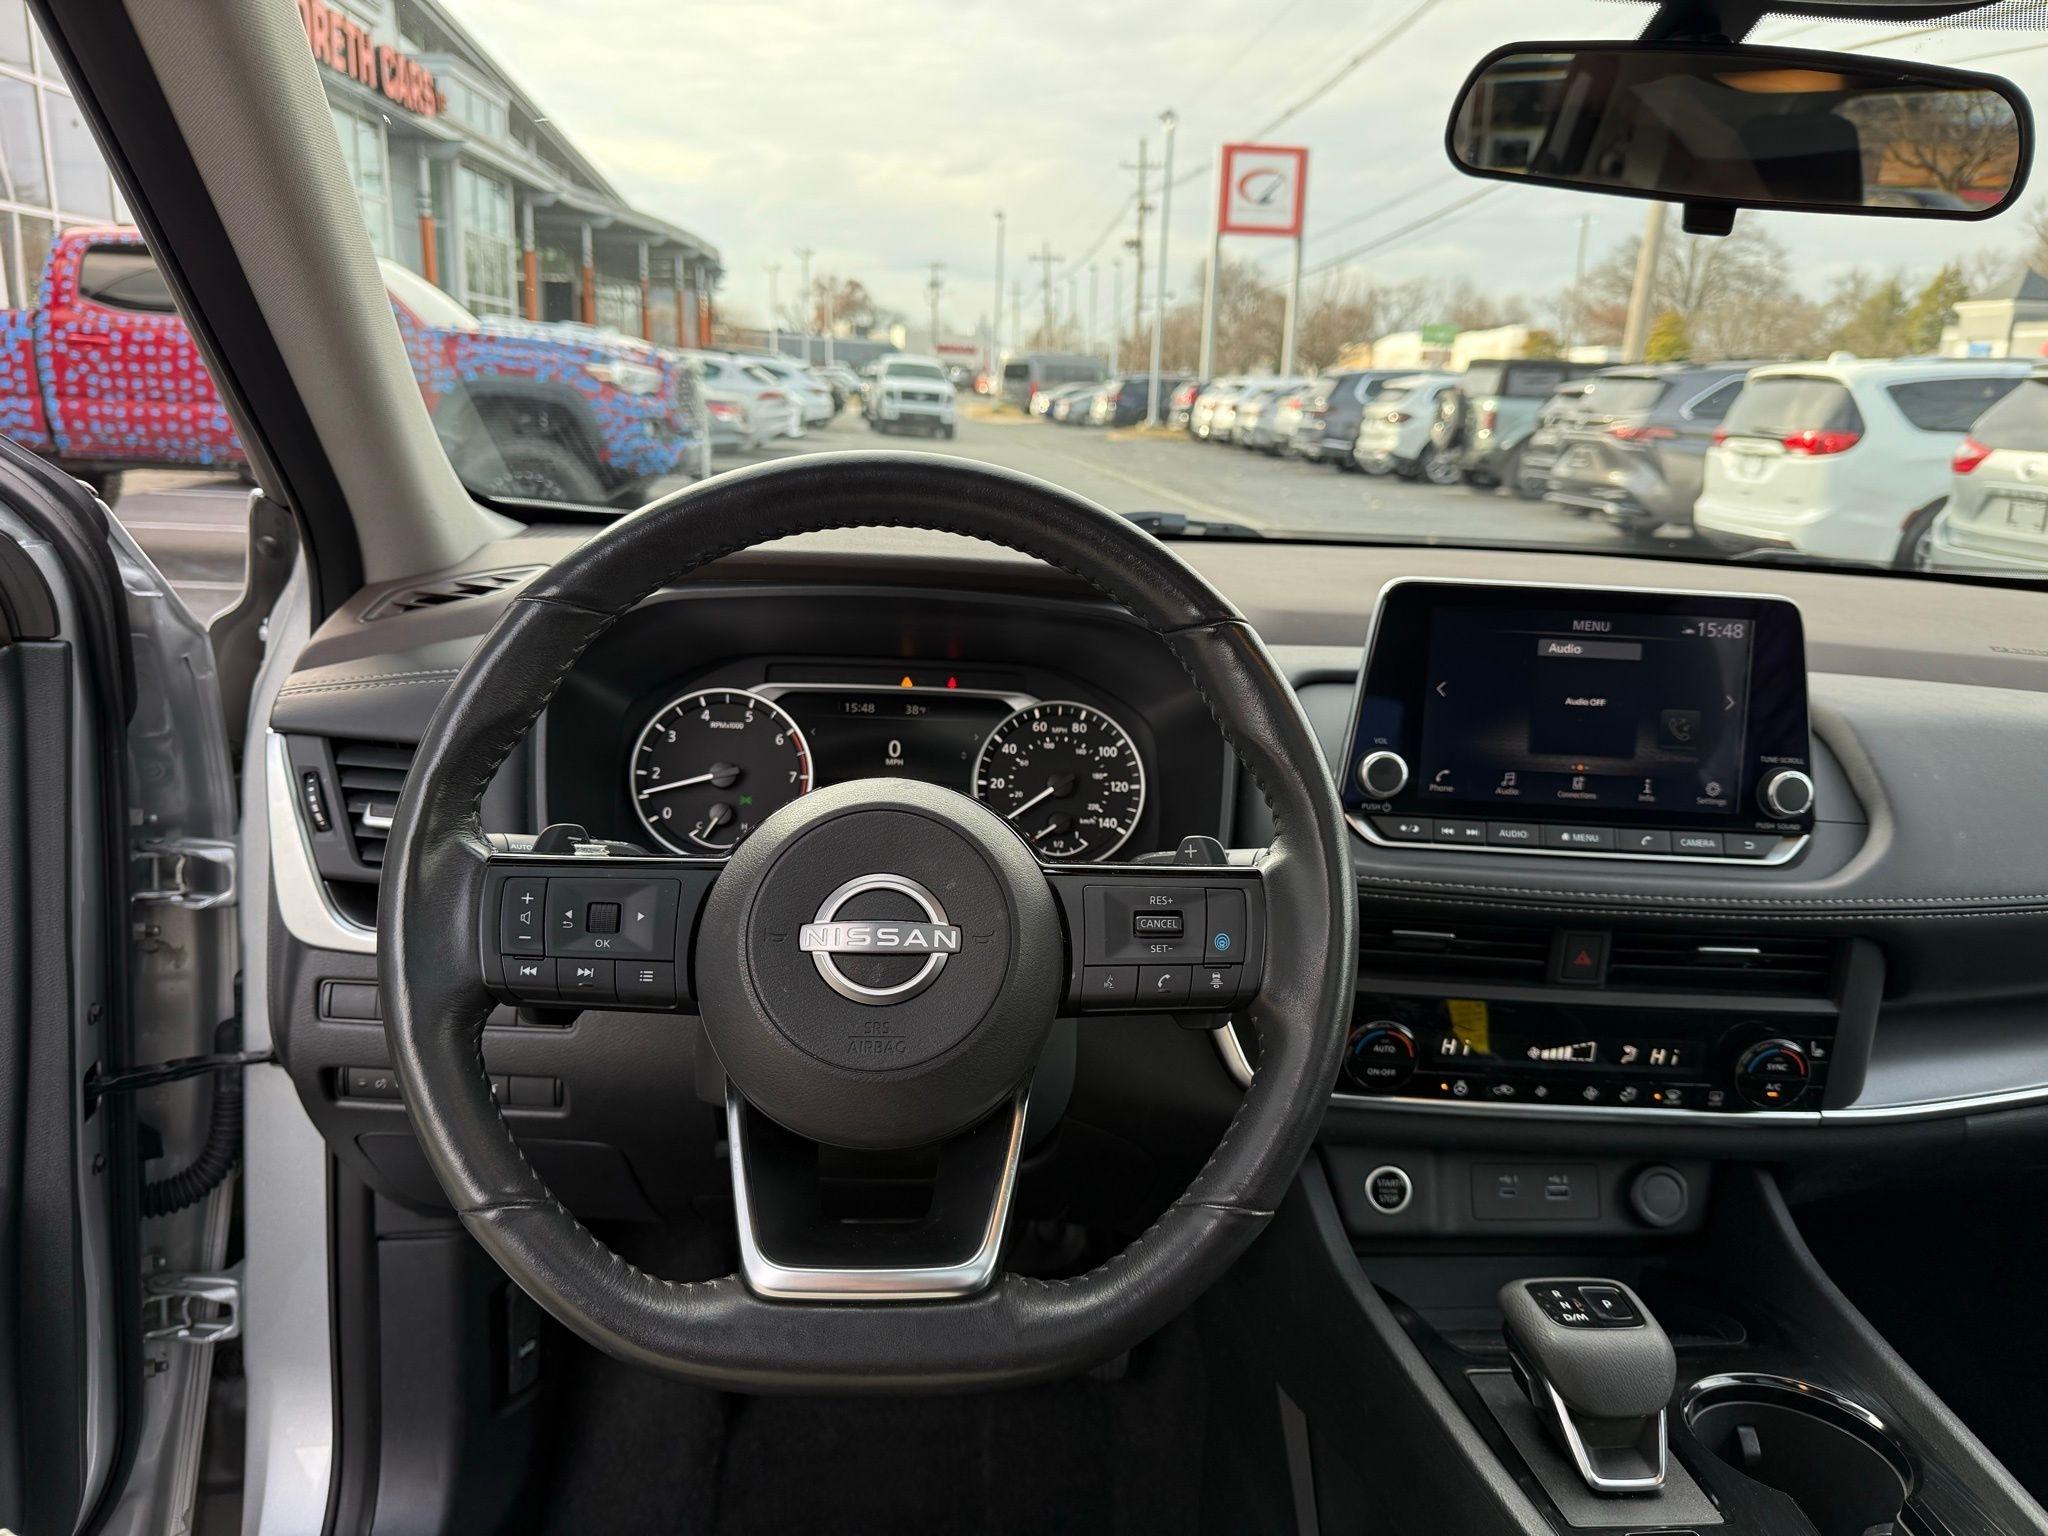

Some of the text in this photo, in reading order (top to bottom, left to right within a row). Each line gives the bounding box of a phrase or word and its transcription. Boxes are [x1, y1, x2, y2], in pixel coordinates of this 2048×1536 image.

[380, 44, 438, 117] CARS
[1573, 620, 1611, 632] MENU
[1698, 622, 1744, 639] 15:48
[1548, 643, 1583, 654] Audio
[1565, 698, 1606, 706] Audio OFF
[845, 703, 875, 713] 15:48
[701, 710, 710, 721] 4
[745, 711, 754, 723] 5
[1032, 722, 1047, 733] 60
[1052, 726, 1068, 734] MPH
[1071, 722, 1087, 734] 80
[667, 731, 677, 743] 3
[775, 733, 784, 745] 6
[888, 740, 902, 758] 0
[1002, 743, 1017, 754] 40
[1099, 746, 1117, 758] 100
[885, 758, 904, 766] MPH
[652, 767, 661, 779] 2
[789, 771, 797, 783] 7
[990, 778, 1005, 789] 20
[1111, 782, 1128, 793] 120
[1429, 784, 1454, 793] Phone
[1495, 787, 1519, 796] Audio
[1557, 790, 1597, 800] Connections
[662, 807, 672, 819] 0
[1099, 818, 1117, 829] 140
[1499, 829, 1528, 838] AUDIO
[1572, 834, 1599, 843] MENU
[1680, 838, 1715, 848] CAMERA
[1149, 896, 1173, 905] RES+
[1140, 919, 1178, 928] CANCEL
[805, 927, 956, 949] NISSAN
[595, 940, 610, 948] OK
[864, 1021, 890, 1034] SRS
[849, 1041, 906, 1054] AIRBAG
[1373, 1045, 1396, 1053] AUTO
[1767, 1063, 1788, 1071] SYNC
[1766, 1083, 1781, 1091] A/C
[1551, 1290, 1563, 1298] R
[1560, 1301, 1572, 1310] N
[1601, 1299, 1613, 1309] P
[1562, 1313, 1590, 1321] D/M
